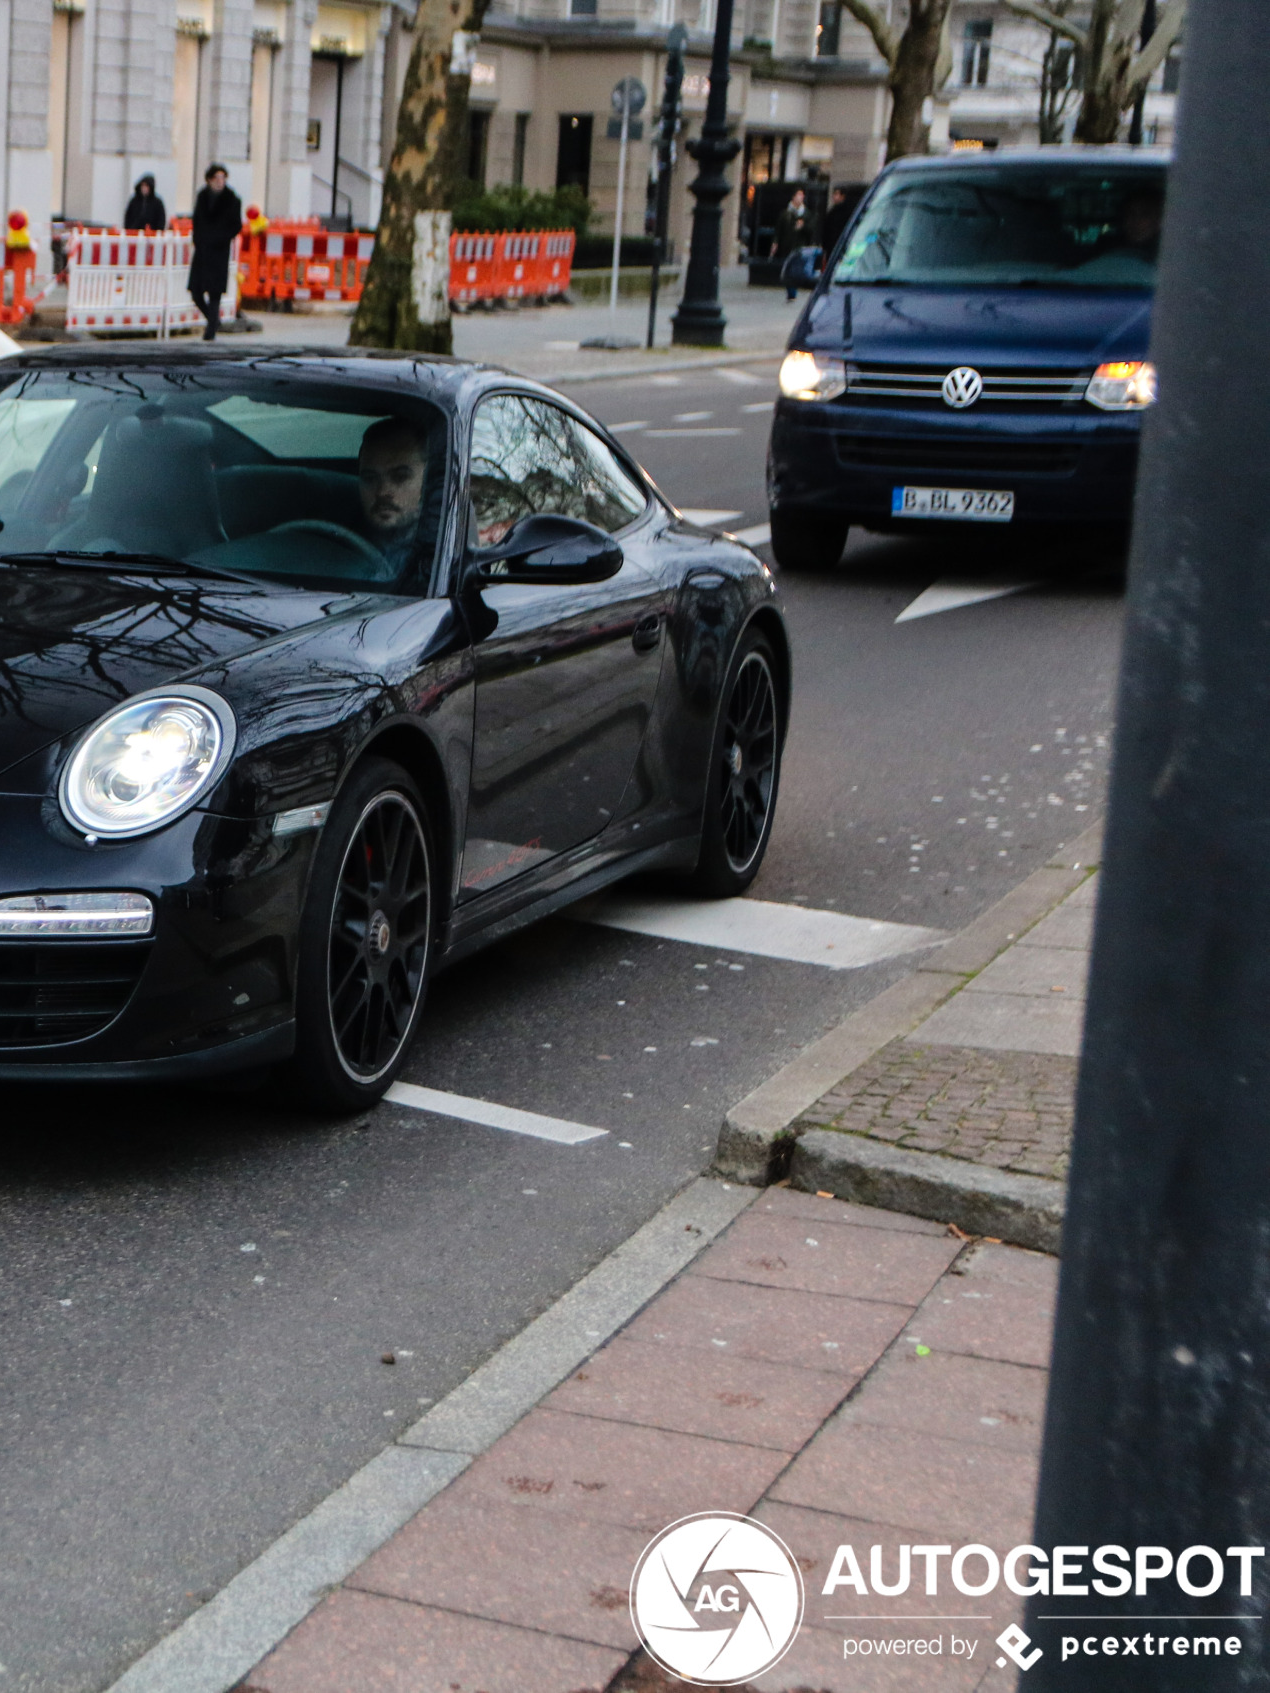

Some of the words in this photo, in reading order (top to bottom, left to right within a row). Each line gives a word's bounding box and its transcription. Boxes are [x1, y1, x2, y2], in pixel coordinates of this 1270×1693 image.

[904, 488, 916, 510] B
[931, 489, 956, 512] BL
[961, 491, 1012, 514] 9362
